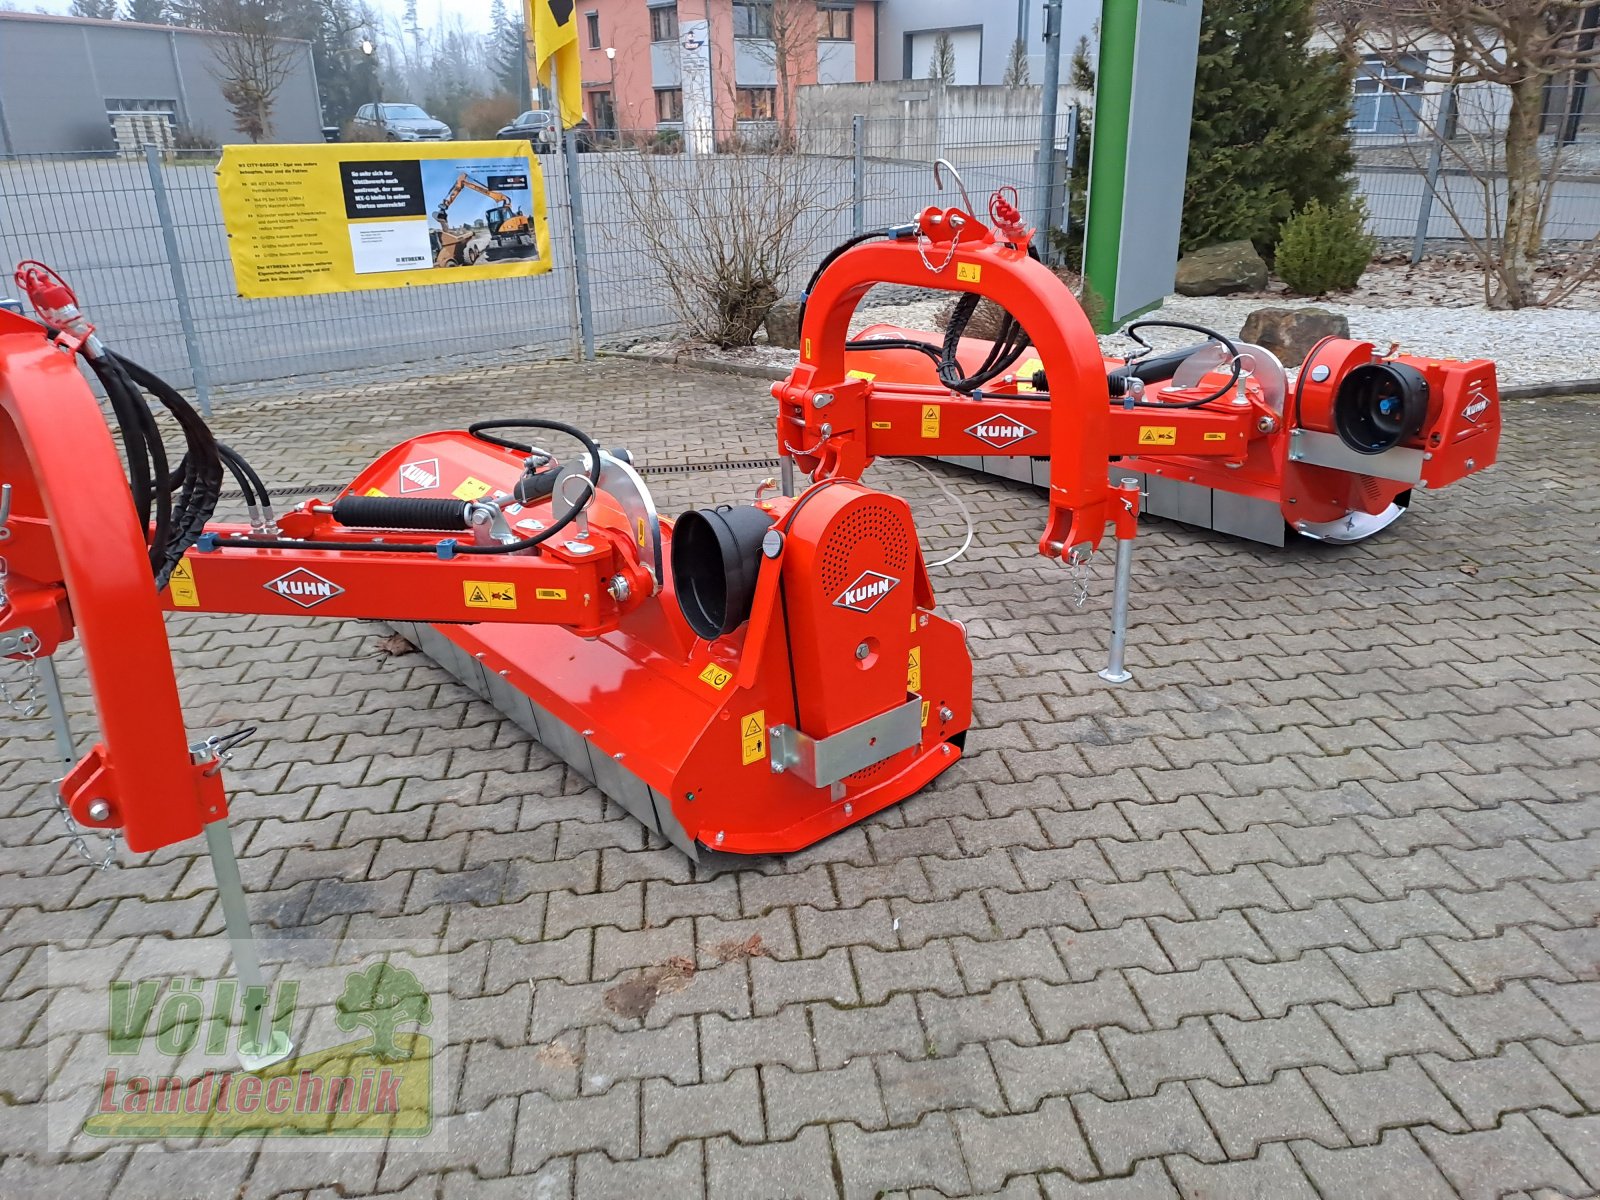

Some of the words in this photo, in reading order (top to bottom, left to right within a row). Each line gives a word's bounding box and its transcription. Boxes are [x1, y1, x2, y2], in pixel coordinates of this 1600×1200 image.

[976, 425, 1024, 438] KUHN
[277, 580, 331, 596] KUHN
[845, 578, 889, 605] KUHN
